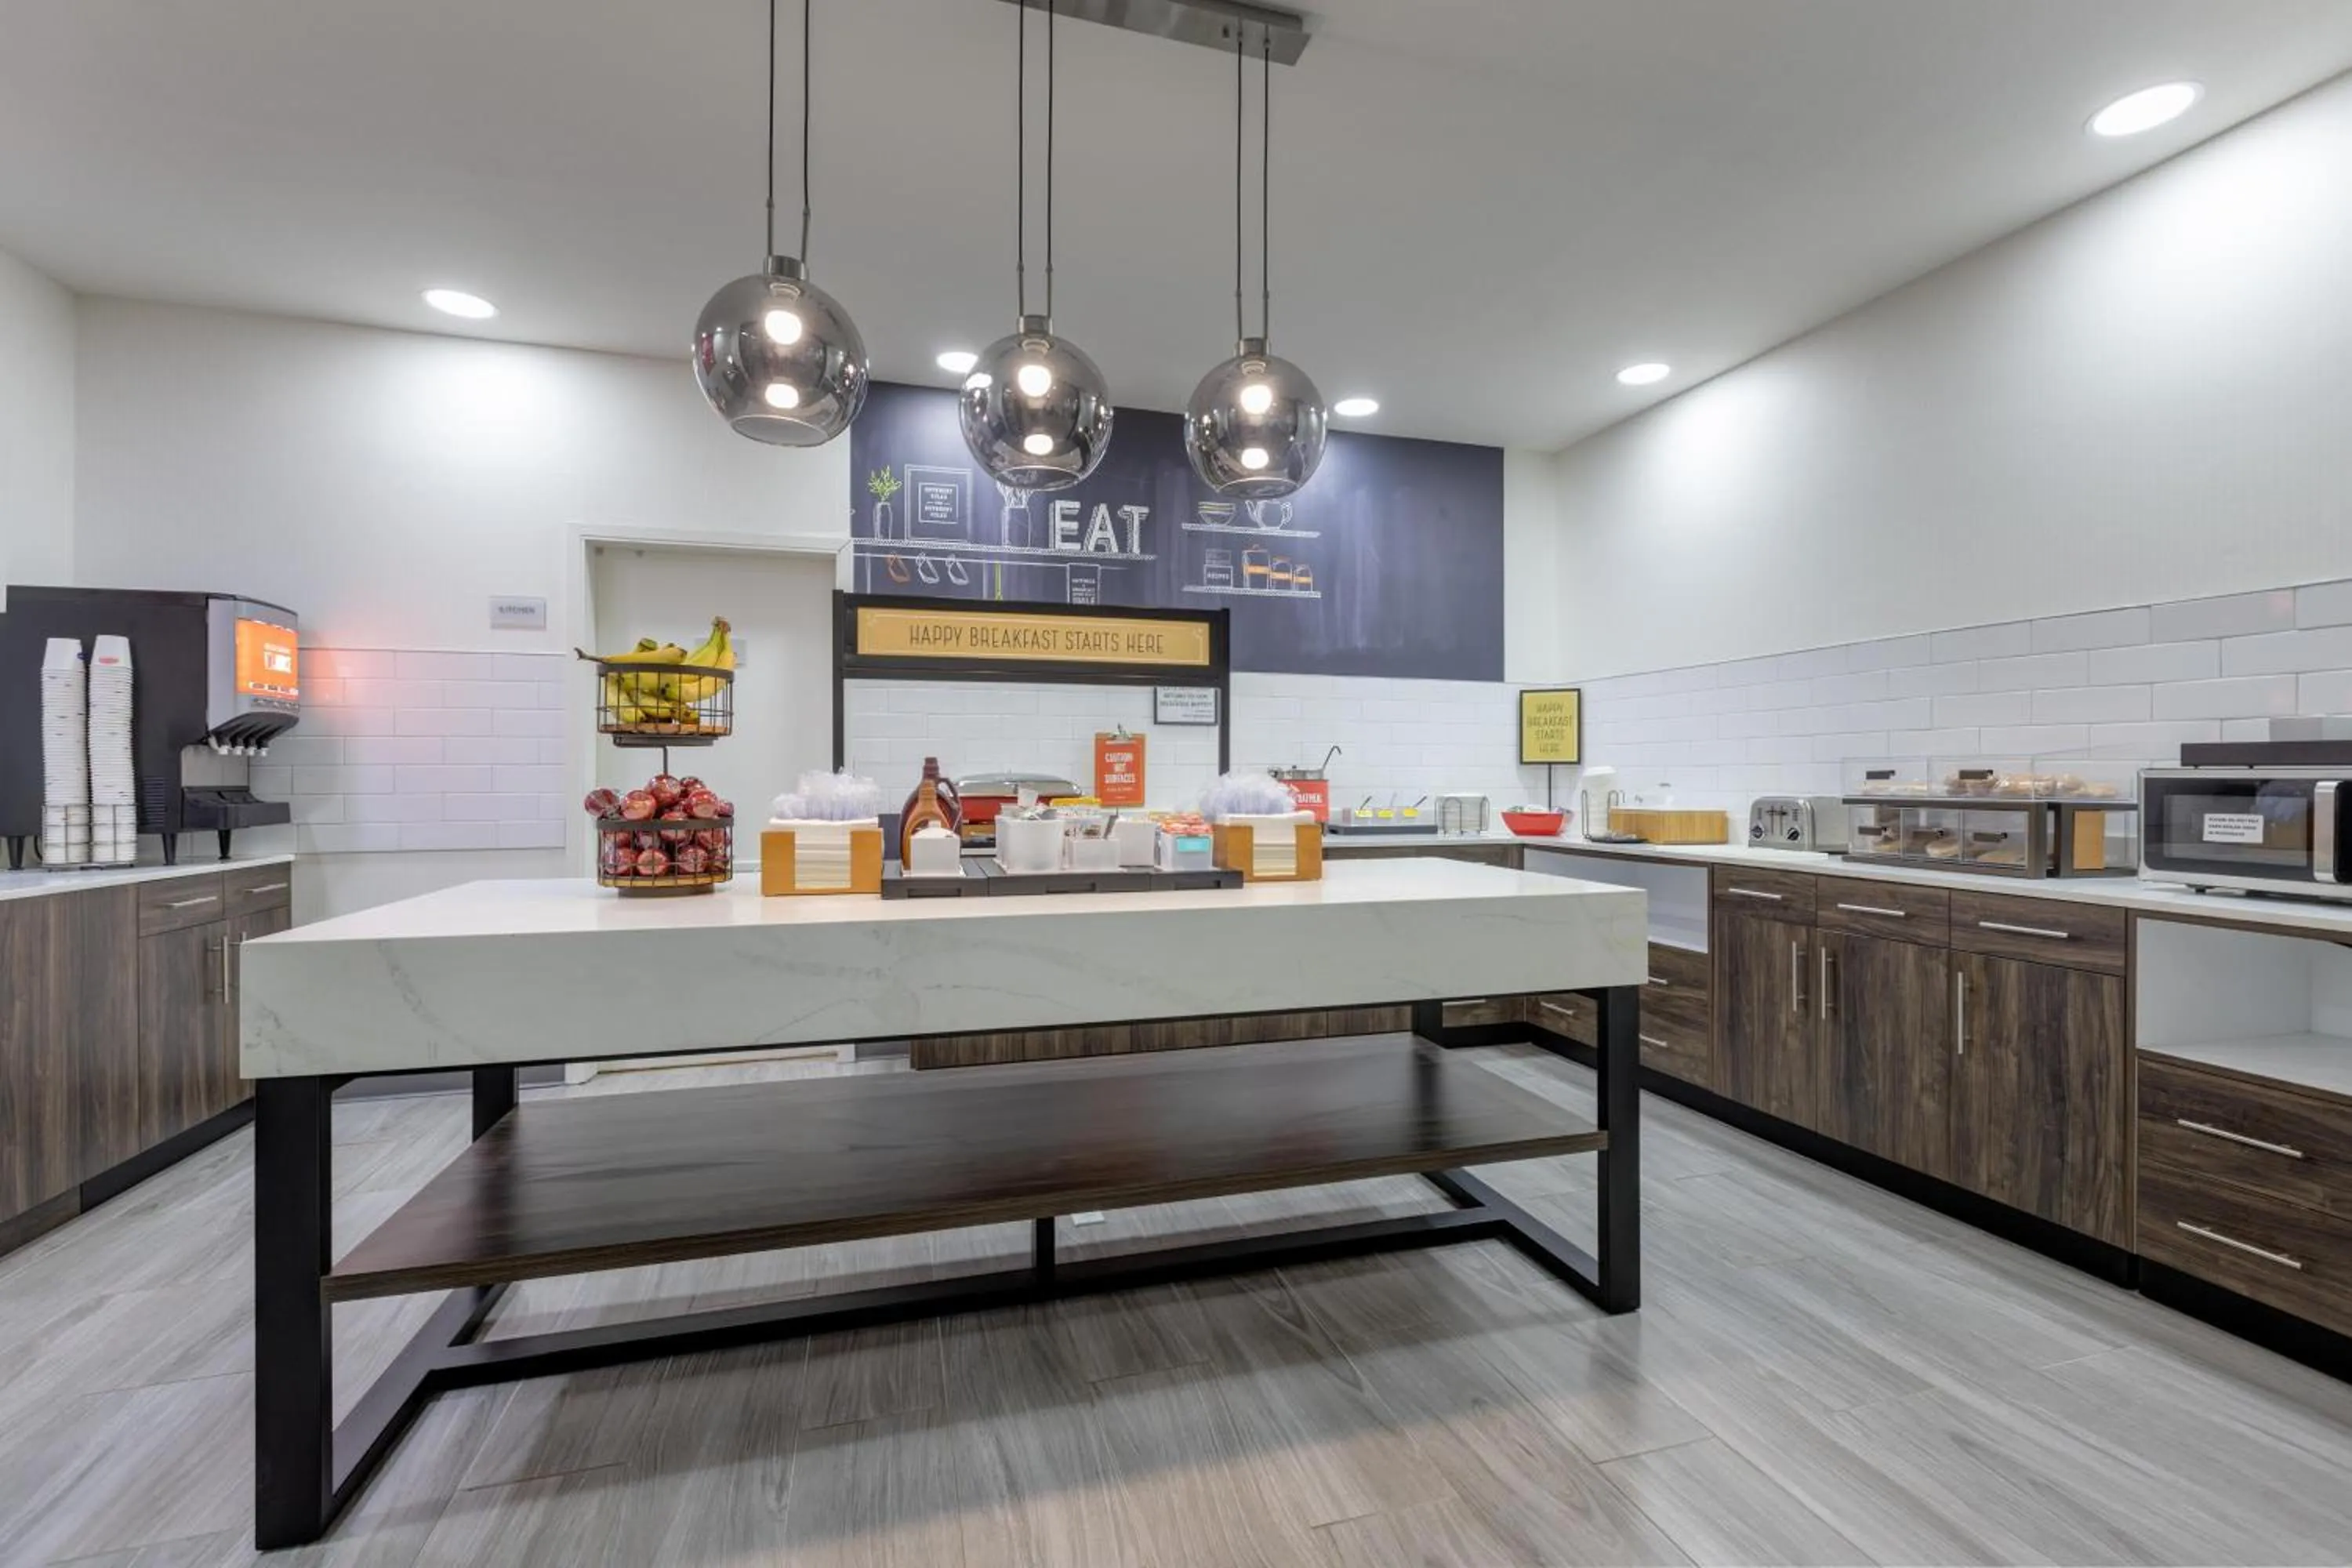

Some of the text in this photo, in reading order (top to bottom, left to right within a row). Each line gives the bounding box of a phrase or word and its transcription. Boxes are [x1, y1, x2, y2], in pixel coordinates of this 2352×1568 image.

[1048, 499, 1150, 554] EAT
[498, 605, 535, 615] KITCHEN
[909, 625, 1163, 654] HAPPY BREAKFAST STARTS HERE
[1526, 715, 1573, 728] BREAKFAST
